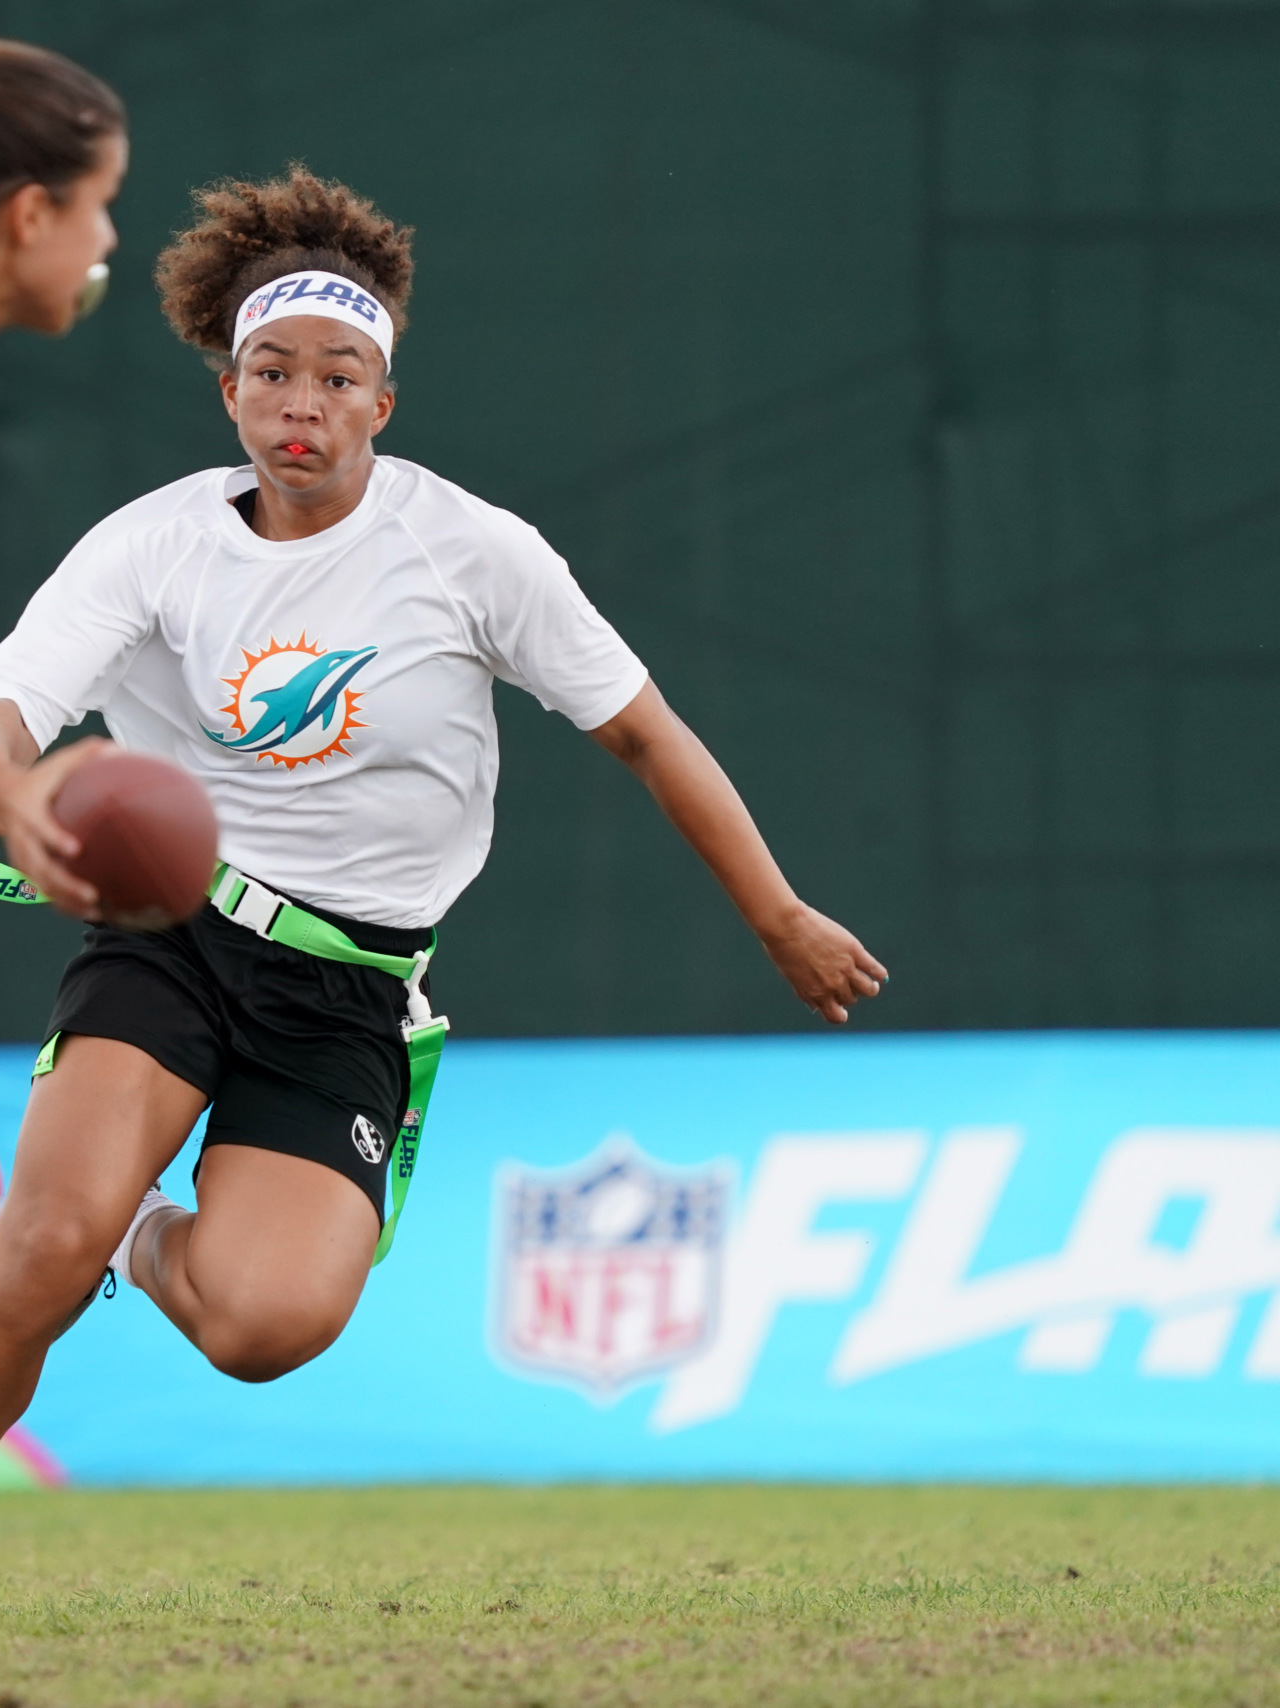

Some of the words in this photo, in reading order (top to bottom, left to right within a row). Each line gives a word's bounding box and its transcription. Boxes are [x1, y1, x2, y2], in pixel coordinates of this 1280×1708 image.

[246, 303, 266, 320] NFL
[260, 278, 378, 324] FLAG
[399, 1125, 419, 1178] FLAG
[518, 1252, 706, 1356] NFL
[652, 1126, 1280, 1431] FLA
